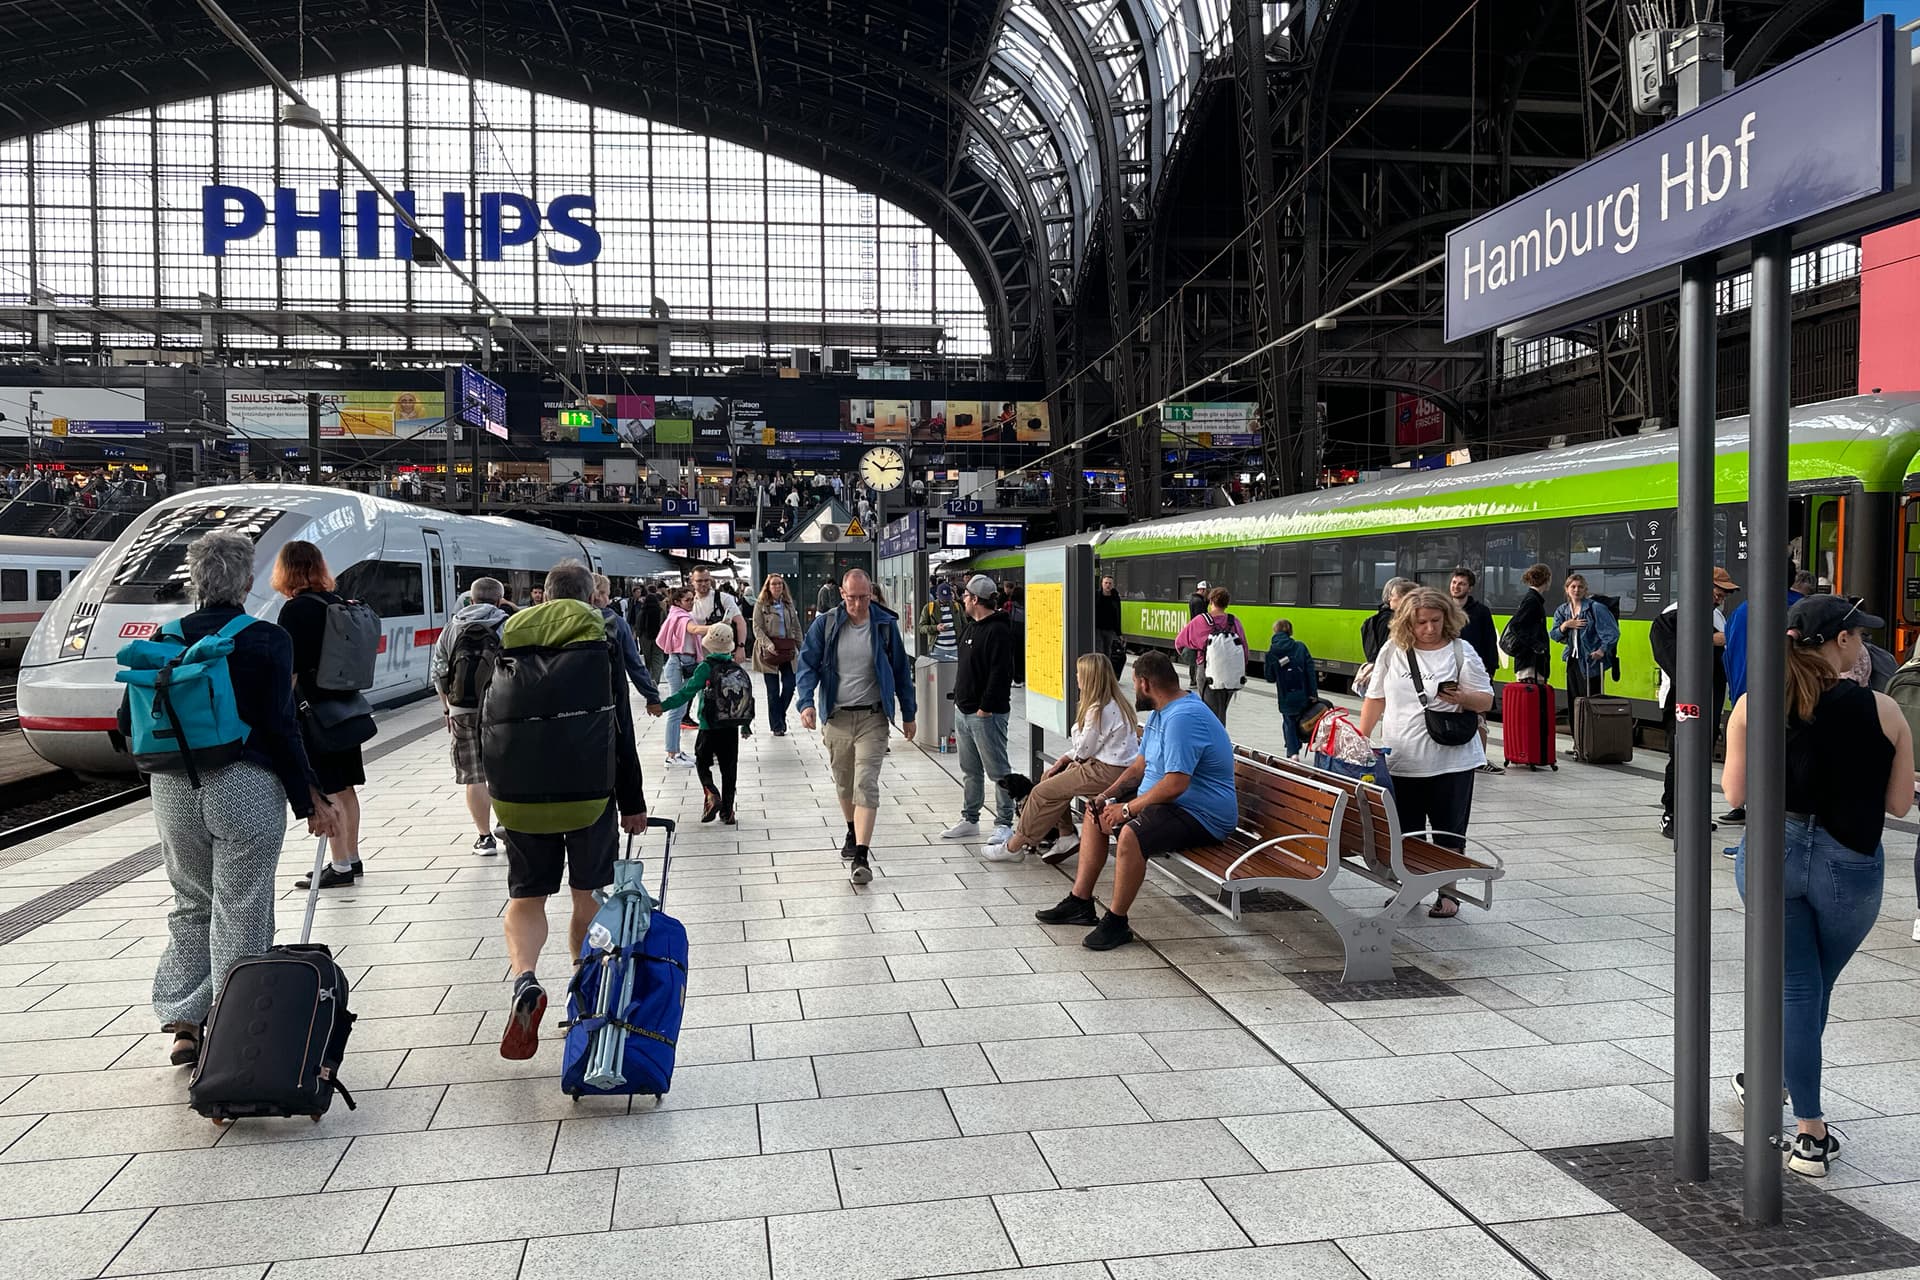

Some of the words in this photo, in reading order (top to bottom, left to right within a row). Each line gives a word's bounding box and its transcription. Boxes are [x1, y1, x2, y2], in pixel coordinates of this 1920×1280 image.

[1463, 183, 1640, 300] Hamburg
[1661, 111, 1756, 221] Hbf
[202, 184, 601, 266] PHILIPS
[1415, 414, 1441, 429] FRISCHE
[667, 500, 676, 511] D
[687, 500, 698, 512] 11
[950, 501, 962, 512] 12
[969, 501, 978, 512] D
[124, 625, 153, 636] DB
[386, 625, 414, 672] ICE
